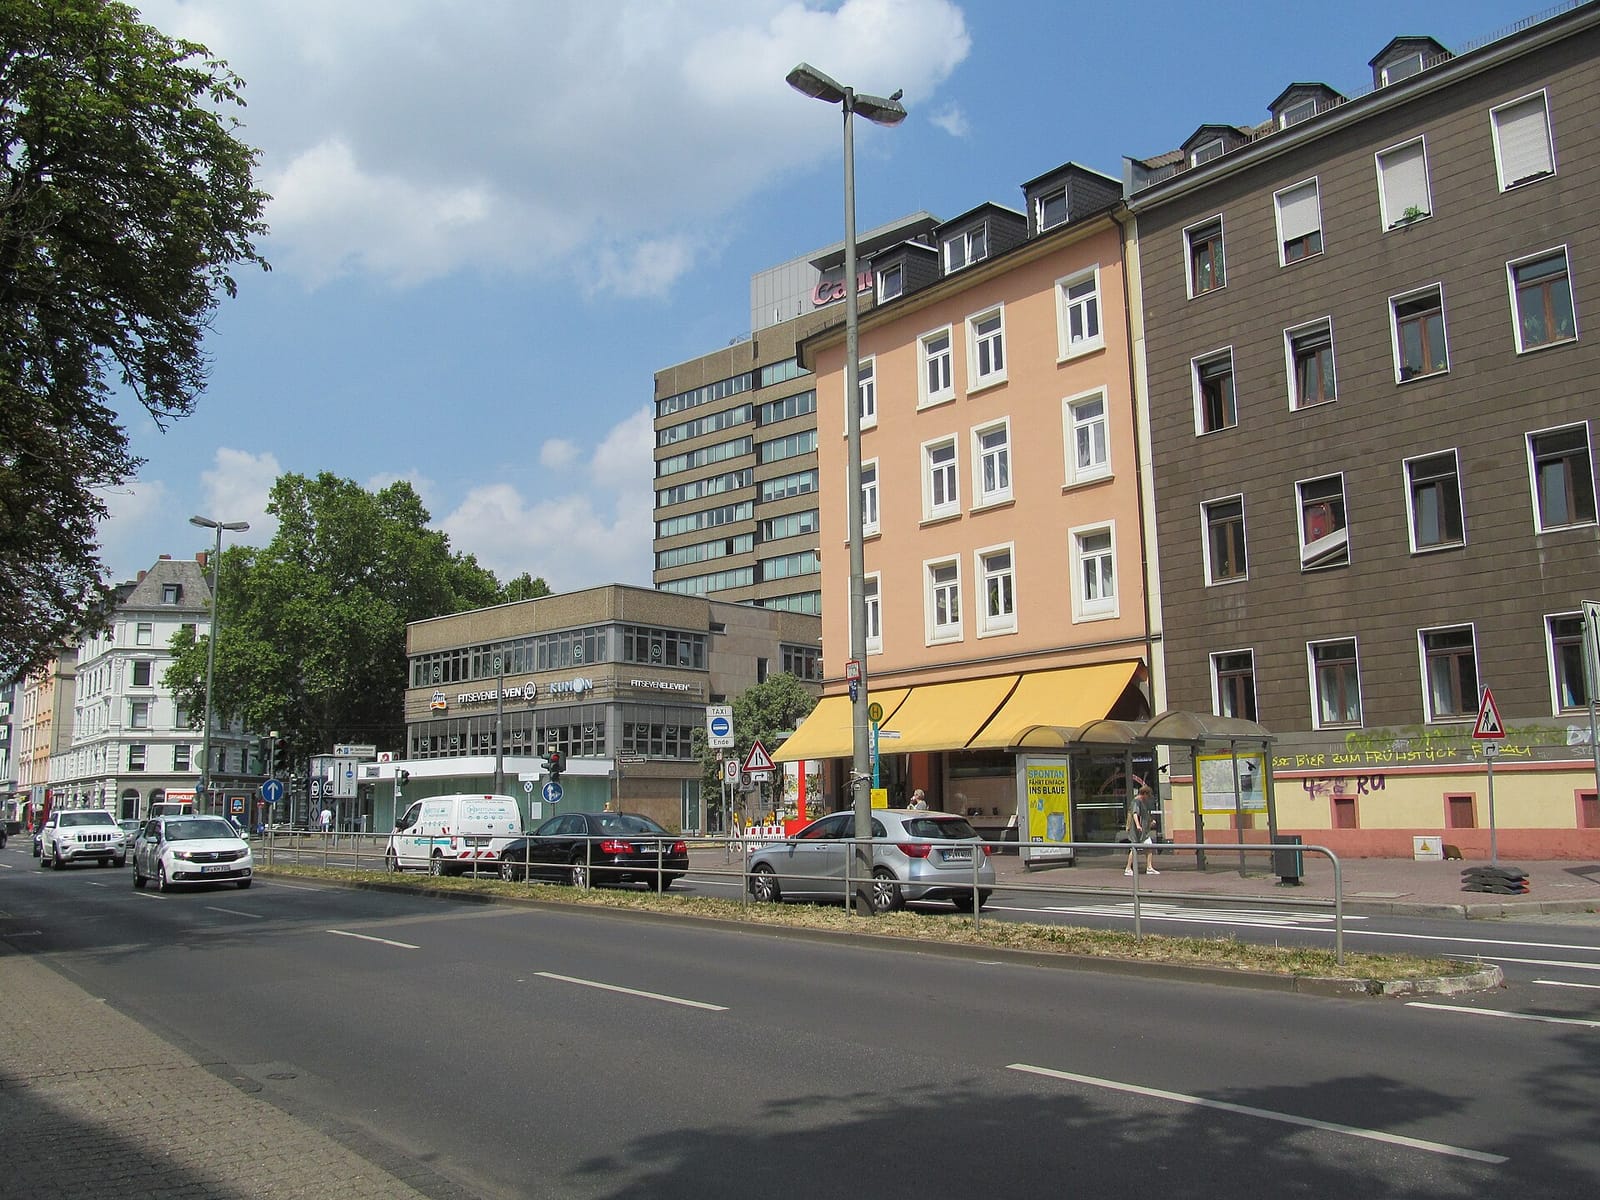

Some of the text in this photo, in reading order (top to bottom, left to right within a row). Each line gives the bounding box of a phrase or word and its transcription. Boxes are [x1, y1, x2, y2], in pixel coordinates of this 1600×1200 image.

[549, 677, 593, 693] KUMON
[871, 706, 880, 719] H
[1028, 769, 1065, 779] SPONTAN
[1029, 786, 1066, 795] INS BLAUE
